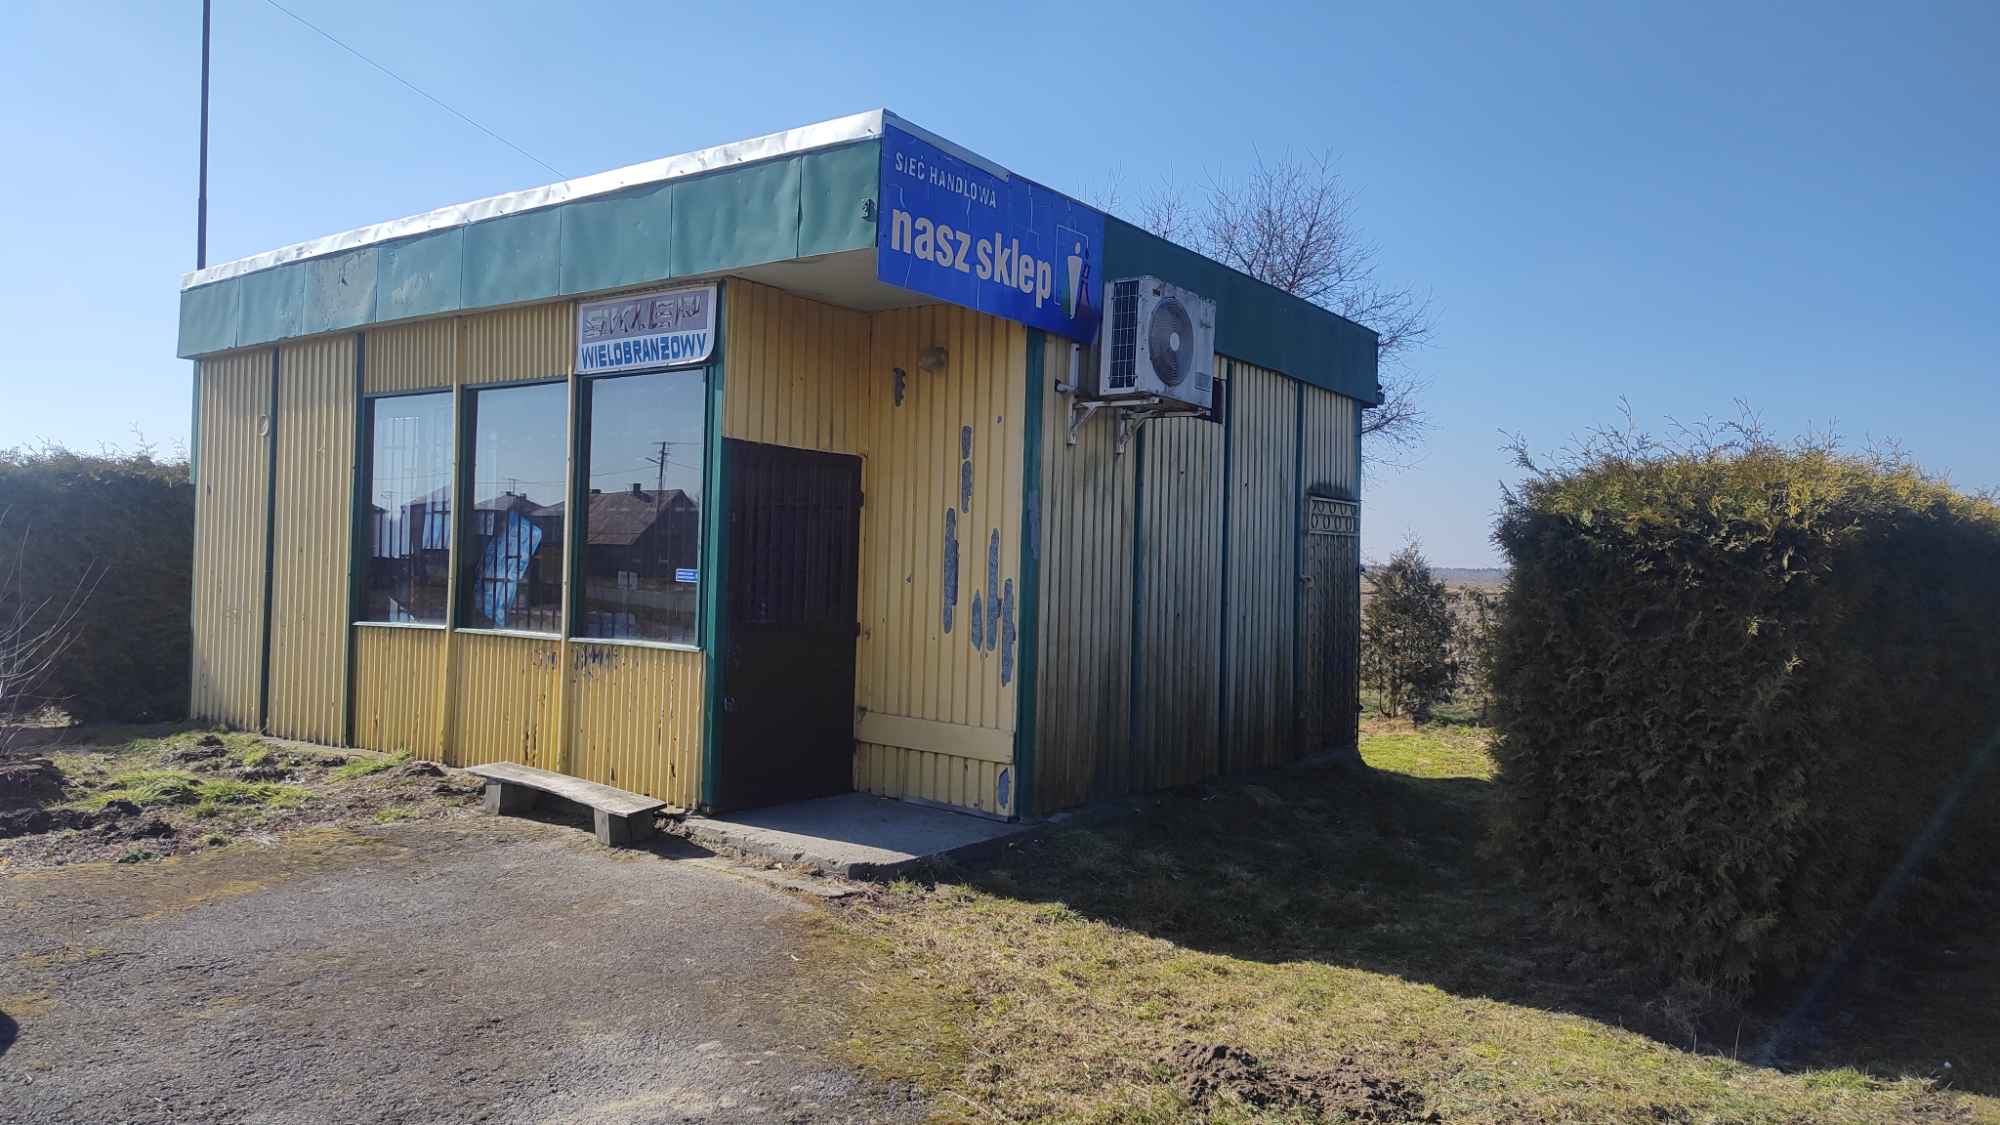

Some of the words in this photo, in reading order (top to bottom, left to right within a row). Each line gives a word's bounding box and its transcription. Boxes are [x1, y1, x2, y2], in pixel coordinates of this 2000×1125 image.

[896, 152, 925, 180] SIEĆ
[929, 166, 996, 208] HANDLOWA
[891, 208, 972, 272] nasz
[976, 232, 1051, 308] sklep
